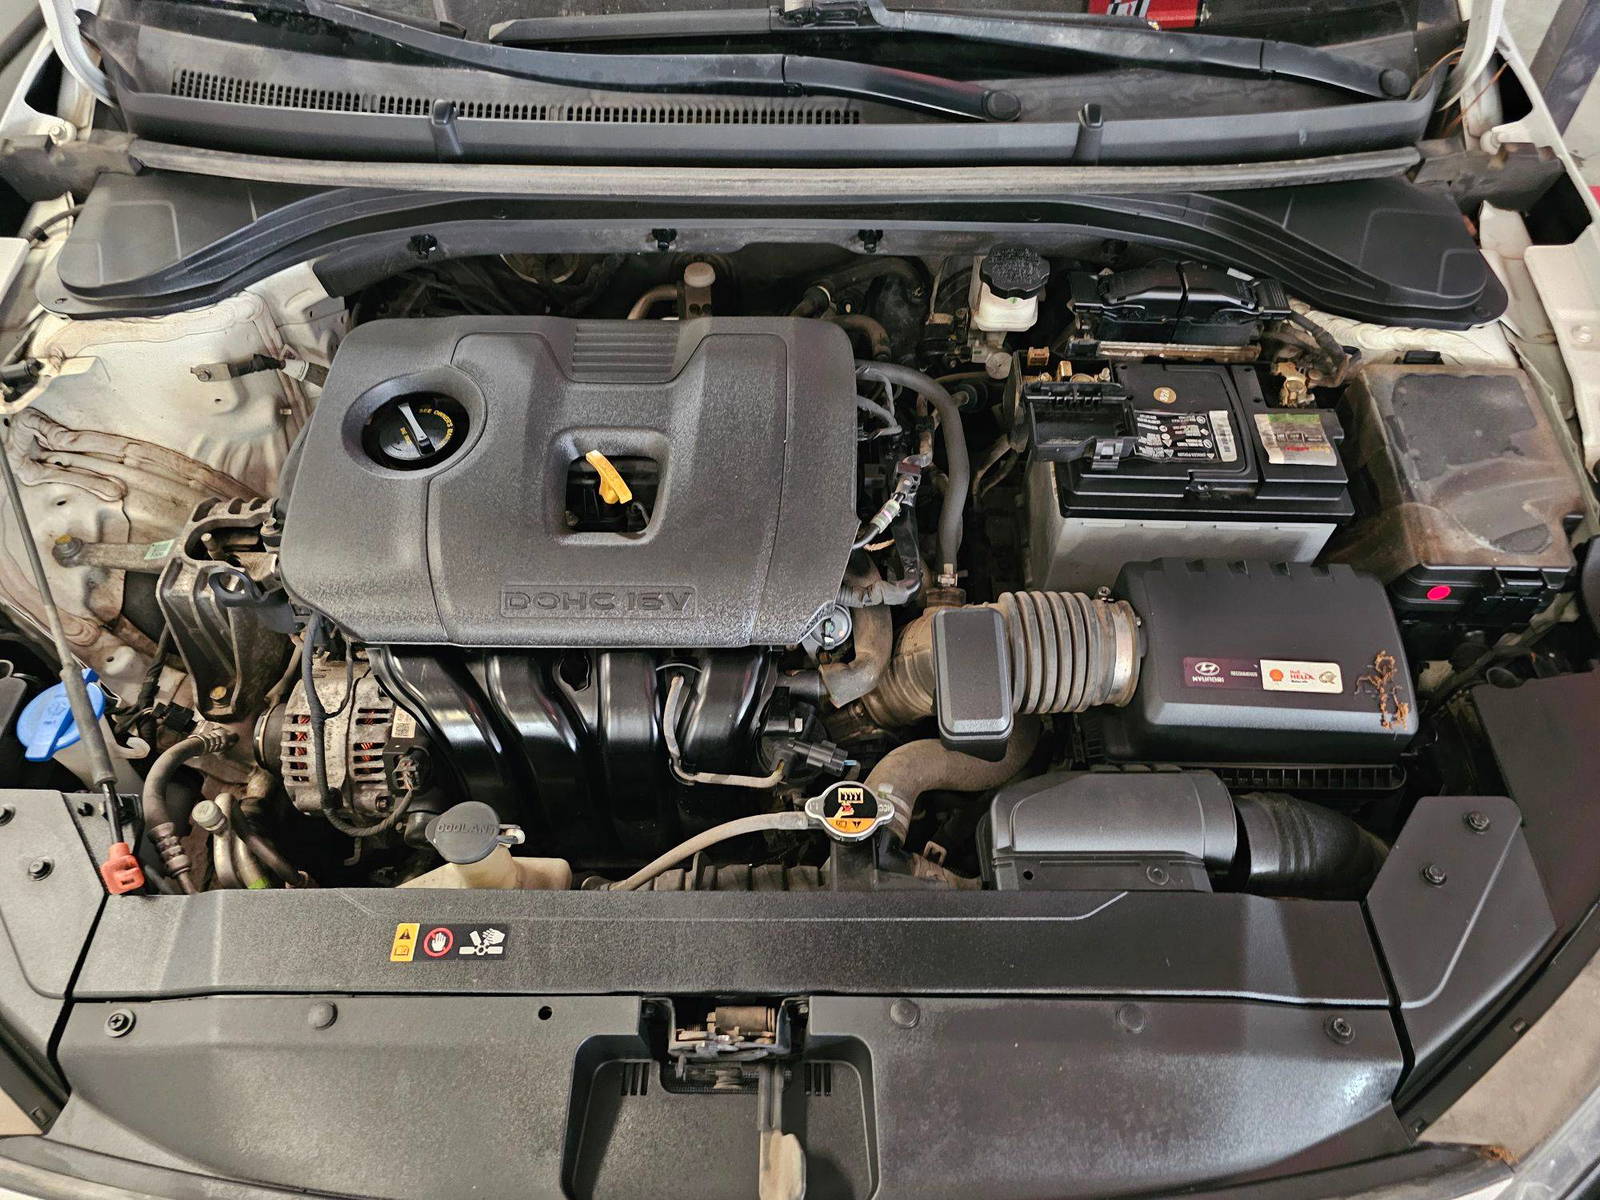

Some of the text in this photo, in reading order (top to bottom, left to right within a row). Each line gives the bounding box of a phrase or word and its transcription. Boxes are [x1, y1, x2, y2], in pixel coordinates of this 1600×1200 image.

[504, 591, 693, 612] DOHC 16V
[1192, 675, 1225, 683] HYUNDAI
[437, 823, 497, 835] COOLANT
